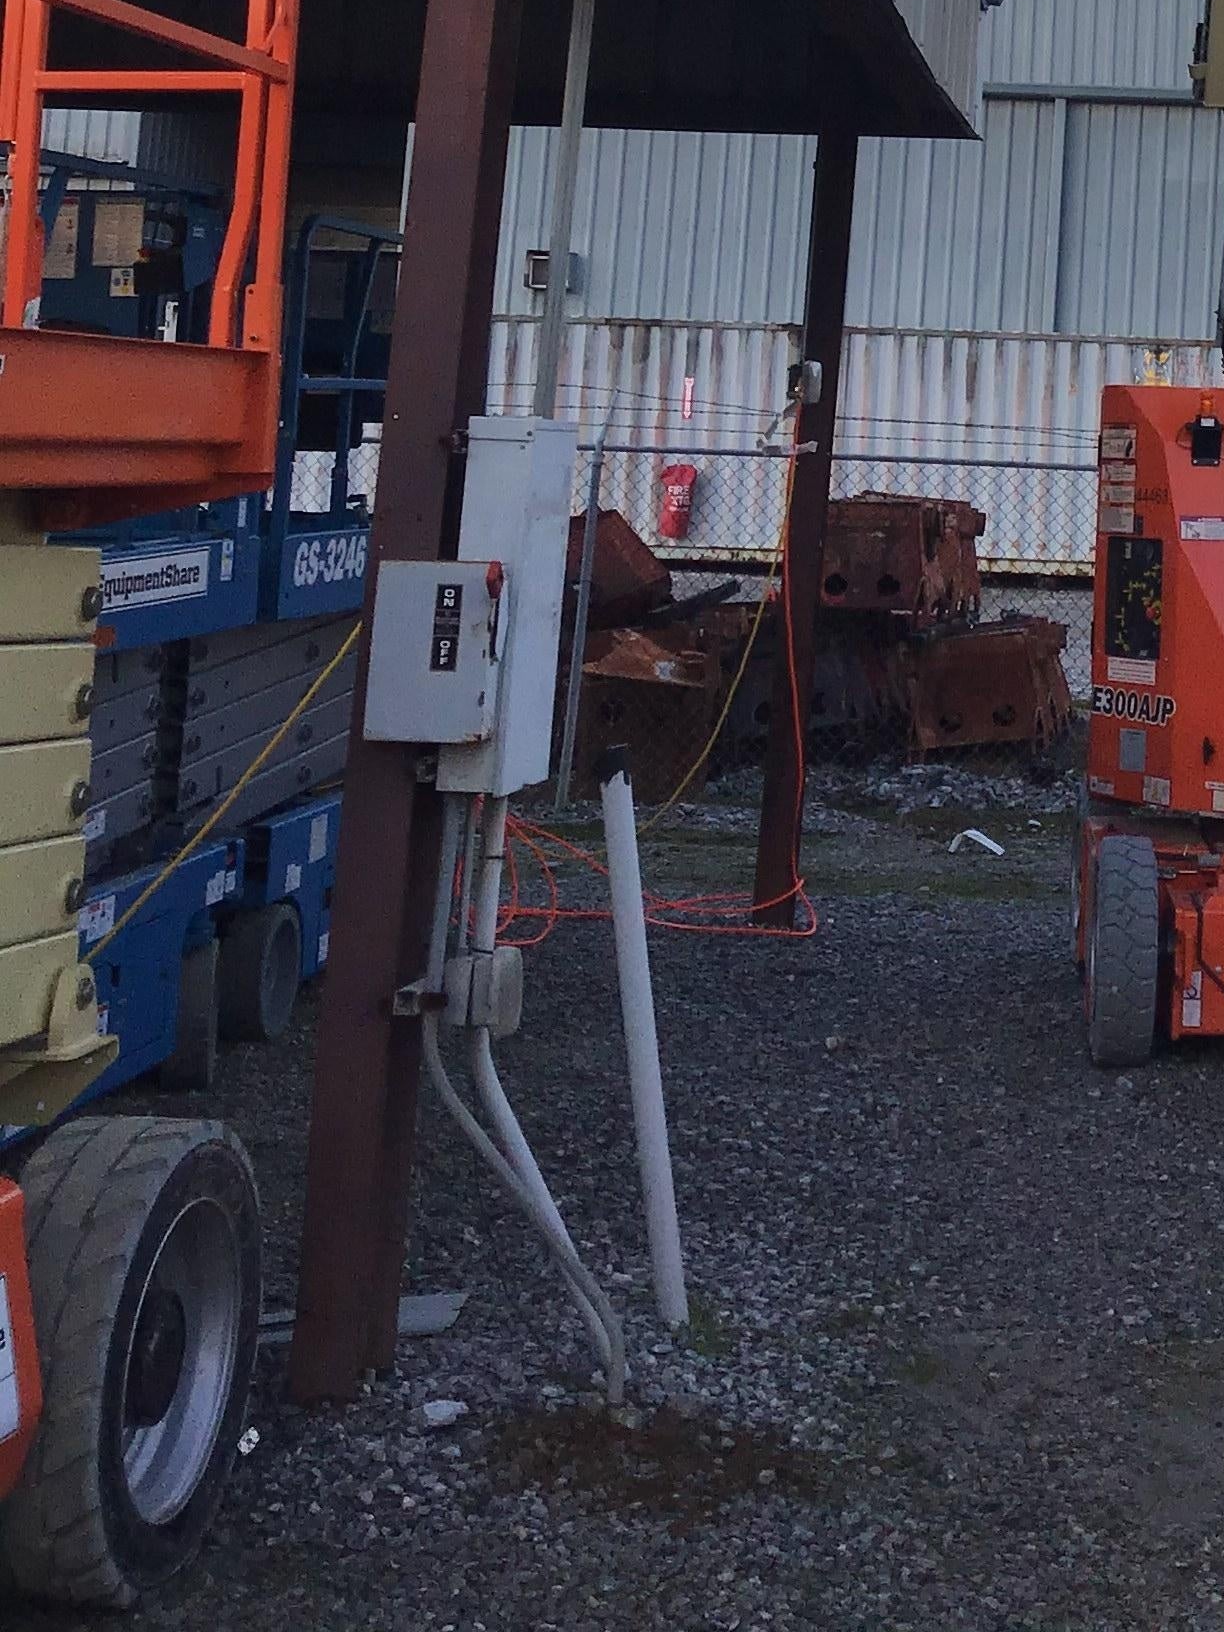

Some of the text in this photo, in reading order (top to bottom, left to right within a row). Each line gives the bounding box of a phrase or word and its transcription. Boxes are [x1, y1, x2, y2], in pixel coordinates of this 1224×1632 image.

[667, 485, 690, 496] FIRE
[293, 535, 367, 587] GS-3246
[443, 589, 455, 607] ON
[440, 640, 451, 665] OFF
[1092, 685, 1176, 726] E300AJP
